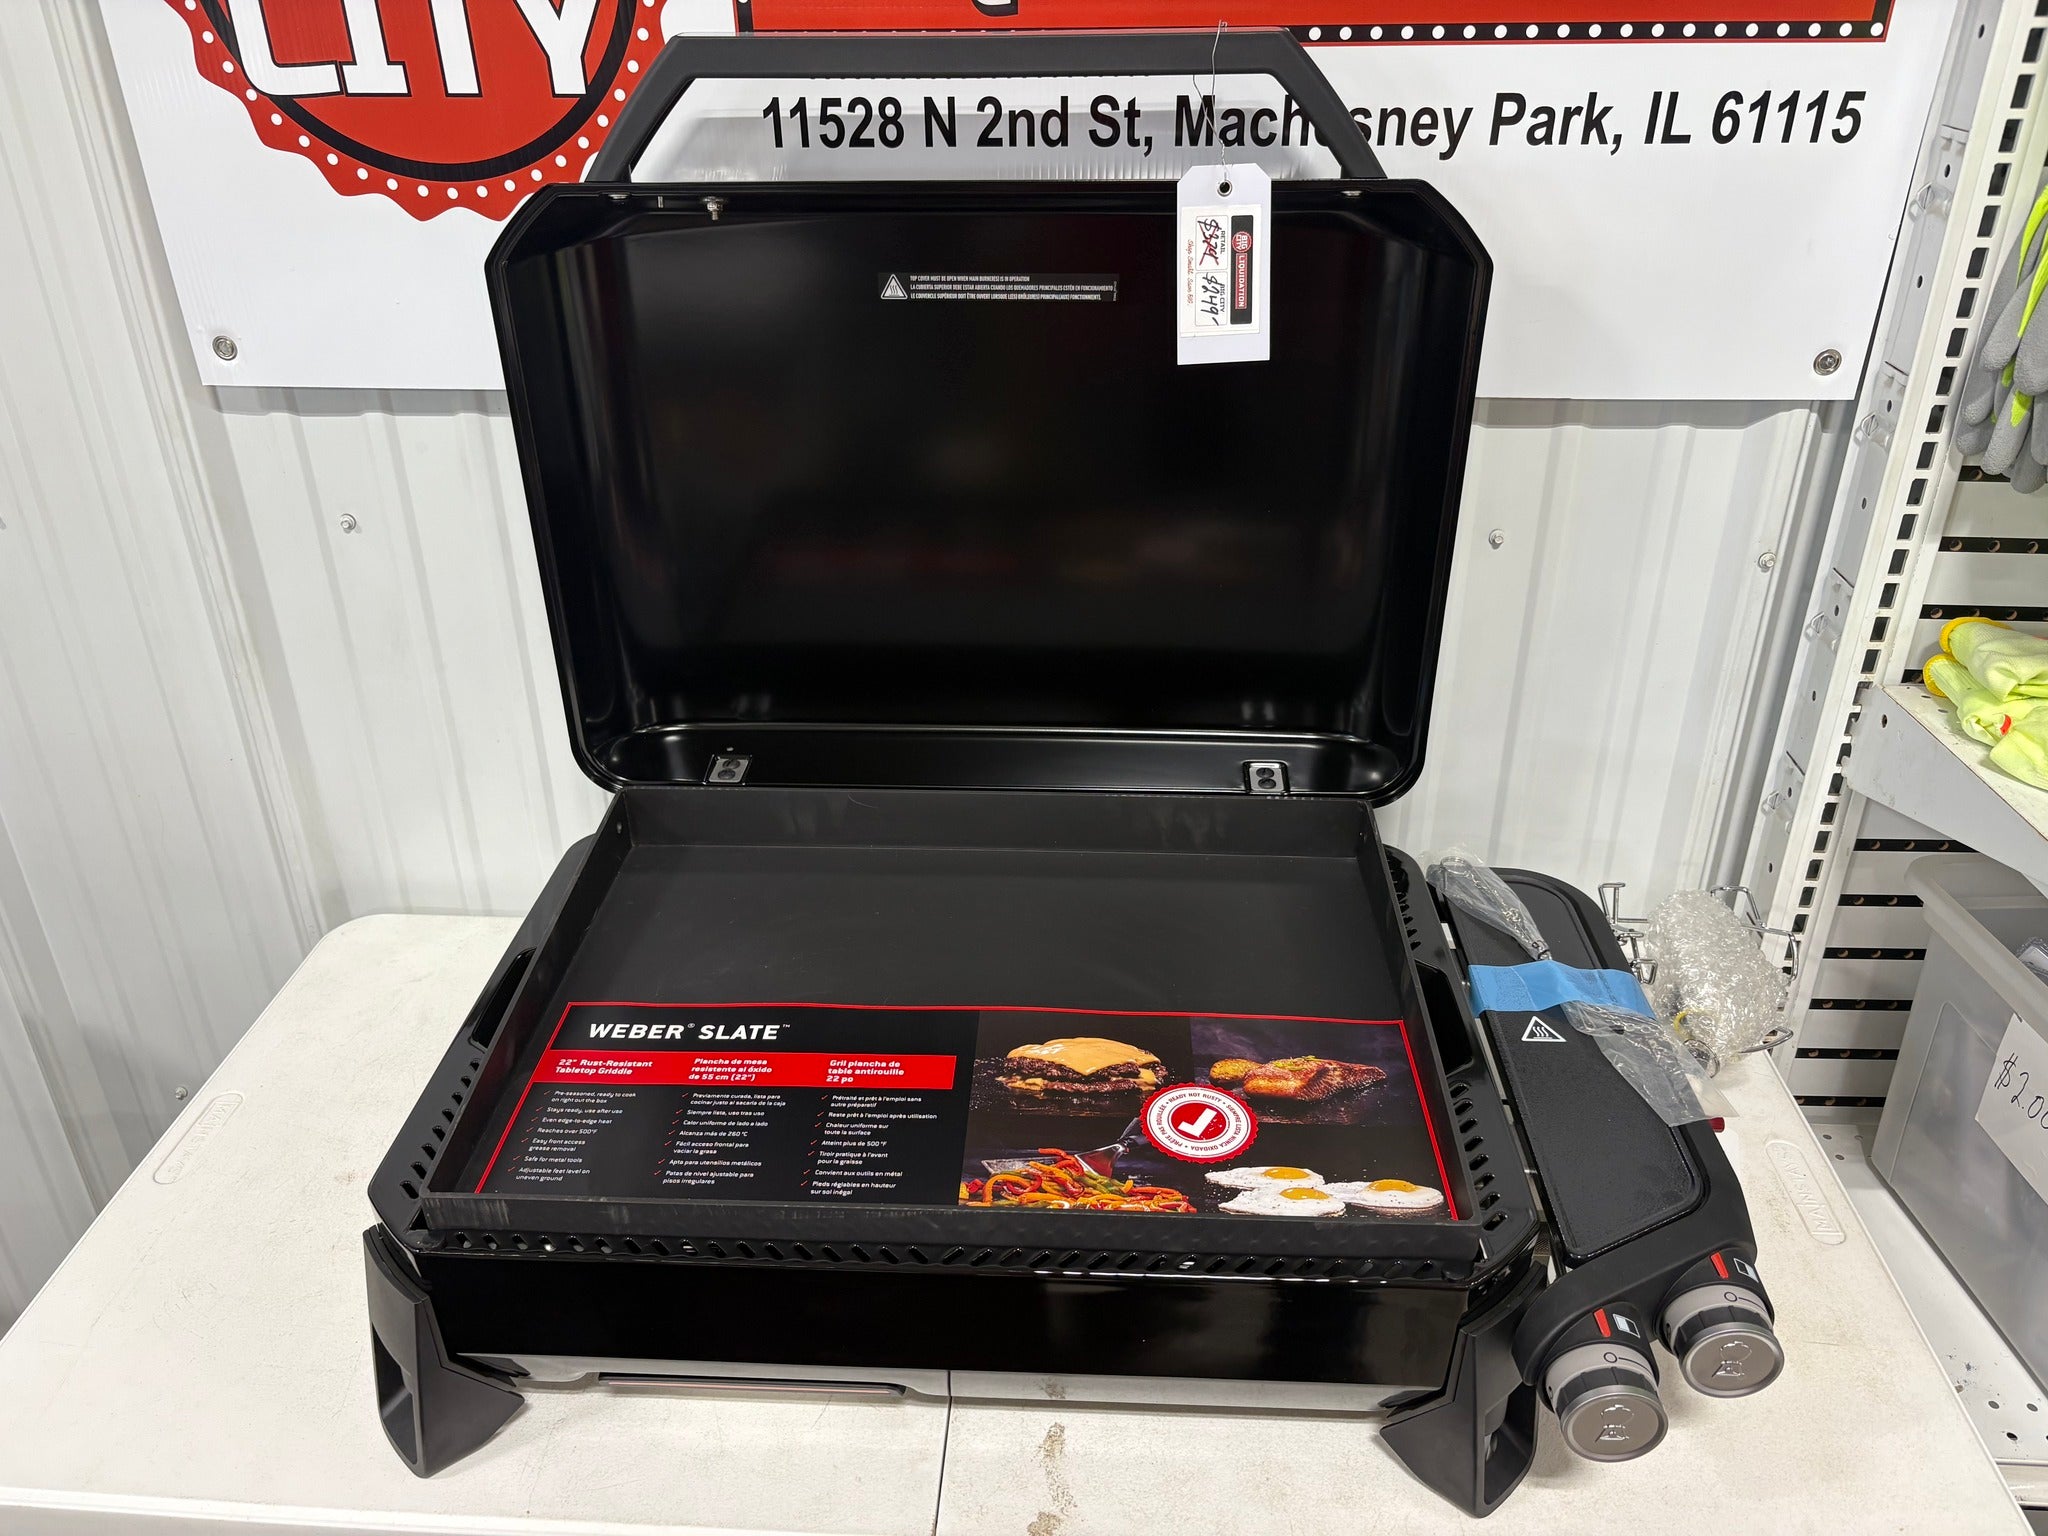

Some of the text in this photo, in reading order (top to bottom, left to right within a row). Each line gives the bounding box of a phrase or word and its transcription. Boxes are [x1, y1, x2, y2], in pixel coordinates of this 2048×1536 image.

[763, 95, 904, 149] 11528
[924, 96, 957, 148] N
[976, 95, 1069, 148] 2nd
[1088, 95, 1153, 157] St,
[1489, 92, 1624, 155] Park,
[1643, 92, 1693, 145] IL
[1711, 90, 1867, 145] 61115
[848, 1060, 886, 1068] plancha
[556, 1066, 632, 1075] Tabletop Griddle
[841, 1076, 854, 1084] po
[1169, 1094, 1187, 1103] READY
[1202, 1094, 1222, 1103] RUSTY
[532, 1137, 548, 1145] Easy
